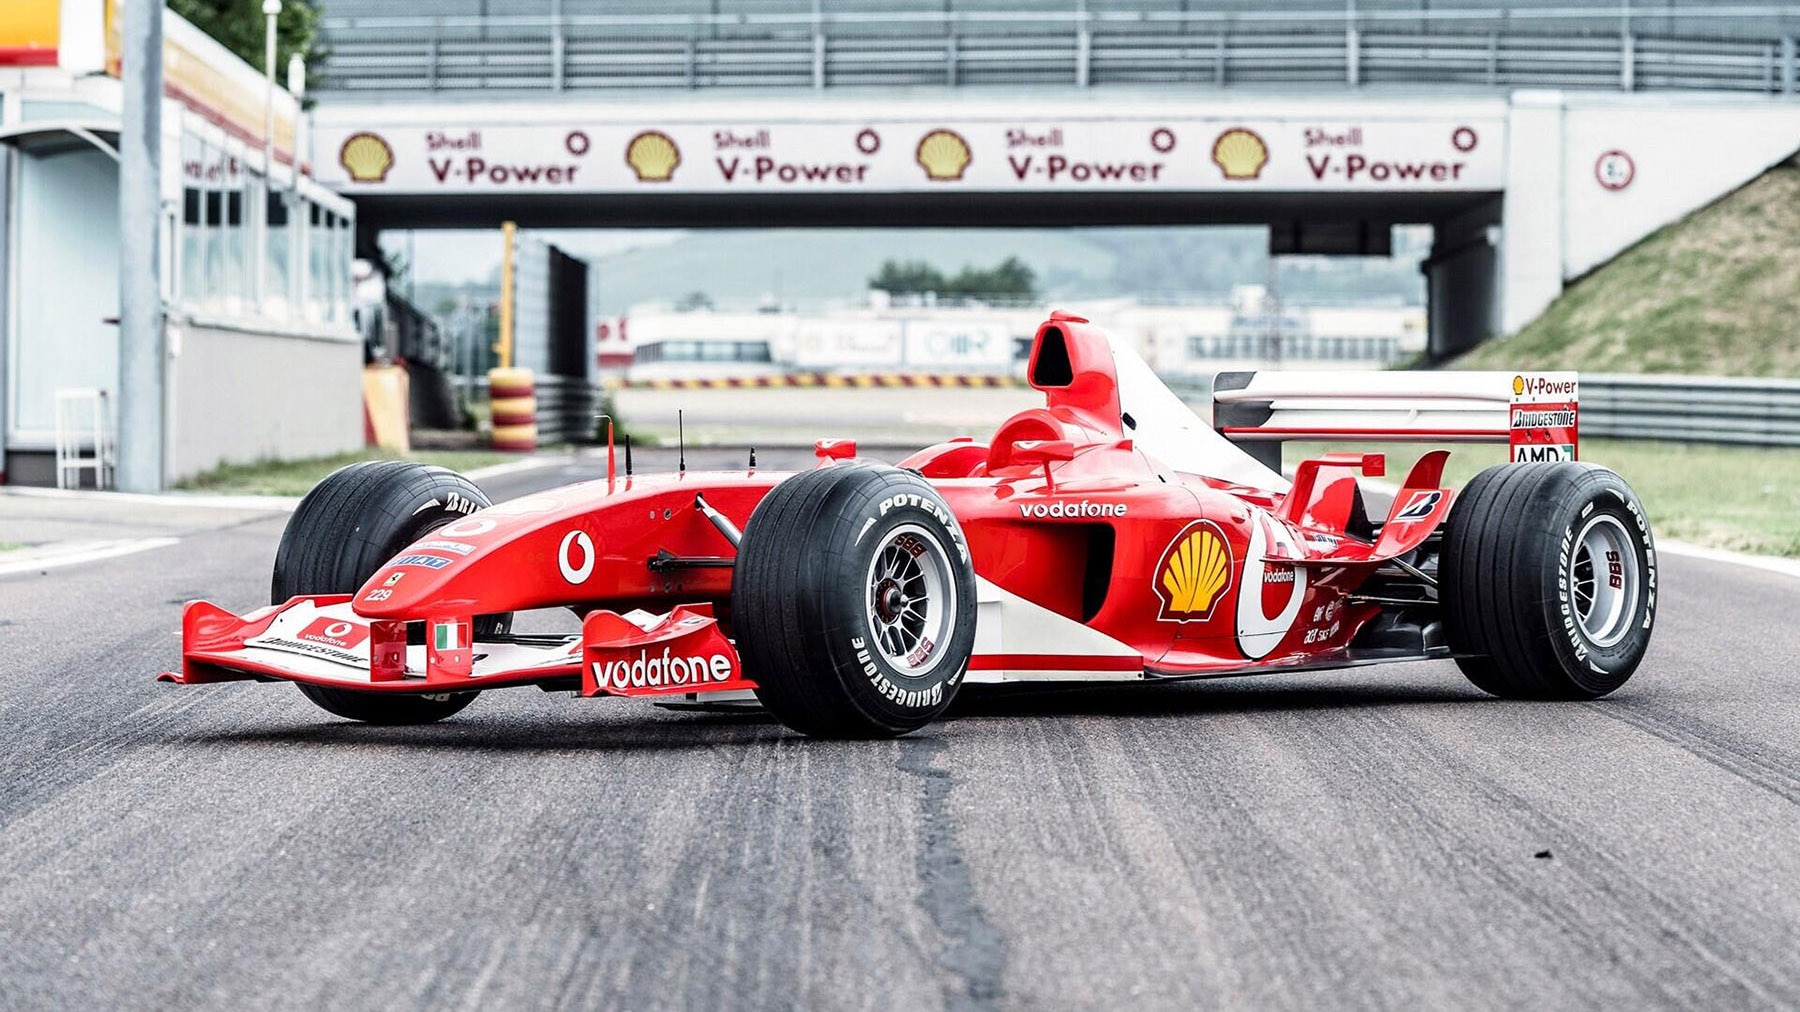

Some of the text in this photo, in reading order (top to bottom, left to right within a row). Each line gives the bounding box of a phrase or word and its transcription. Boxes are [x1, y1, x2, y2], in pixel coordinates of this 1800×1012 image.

[427, 131, 481, 150] Shell
[714, 130, 770, 148] Shell
[1006, 128, 1063, 147] Shell
[1304, 127, 1362, 146] Shell
[1517, 447, 1559, 462] AMD
[1019, 500, 1128, 518] vodafone
[879, 493, 968, 566] POTENZA
[1605, 550, 1622, 590] BBS
[1626, 501, 1657, 630] POTENZA
[1264, 568, 1295, 583] vodafone
[364, 590, 393, 602] 229
[304, 633, 347, 647] vodafone
[592, 646, 732, 689] vodafone
